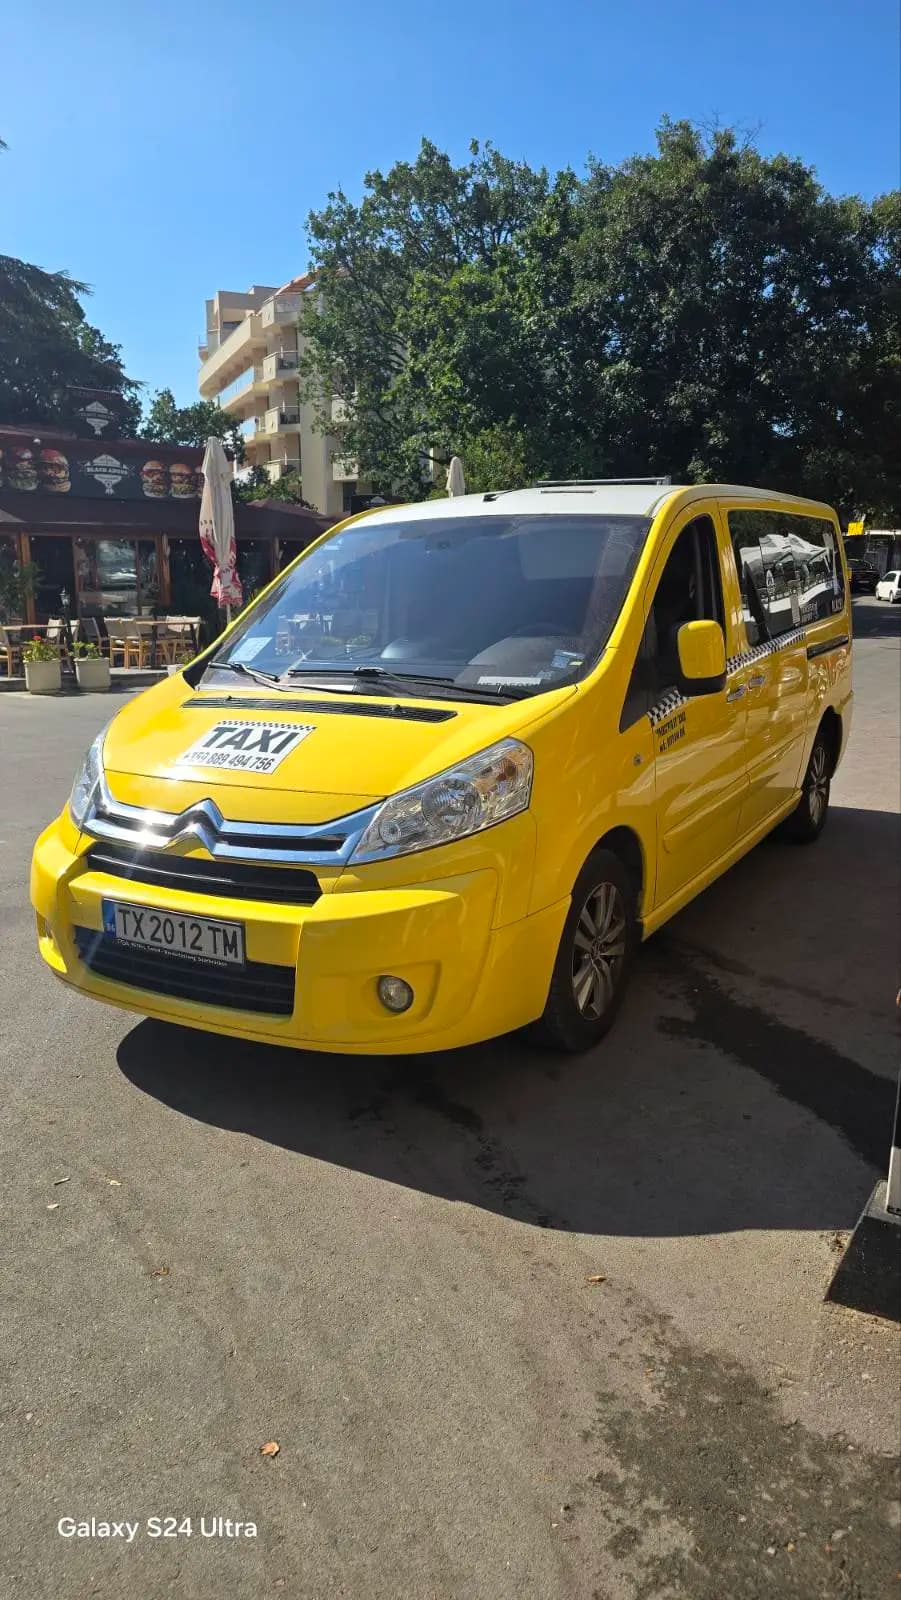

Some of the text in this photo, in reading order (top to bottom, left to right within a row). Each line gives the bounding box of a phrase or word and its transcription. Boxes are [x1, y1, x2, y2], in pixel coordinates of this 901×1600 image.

[202, 726, 300, 754] TAXI
[206, 752, 230, 766] 889
[228, 754, 252, 768] 494
[250, 757, 275, 771] 756
